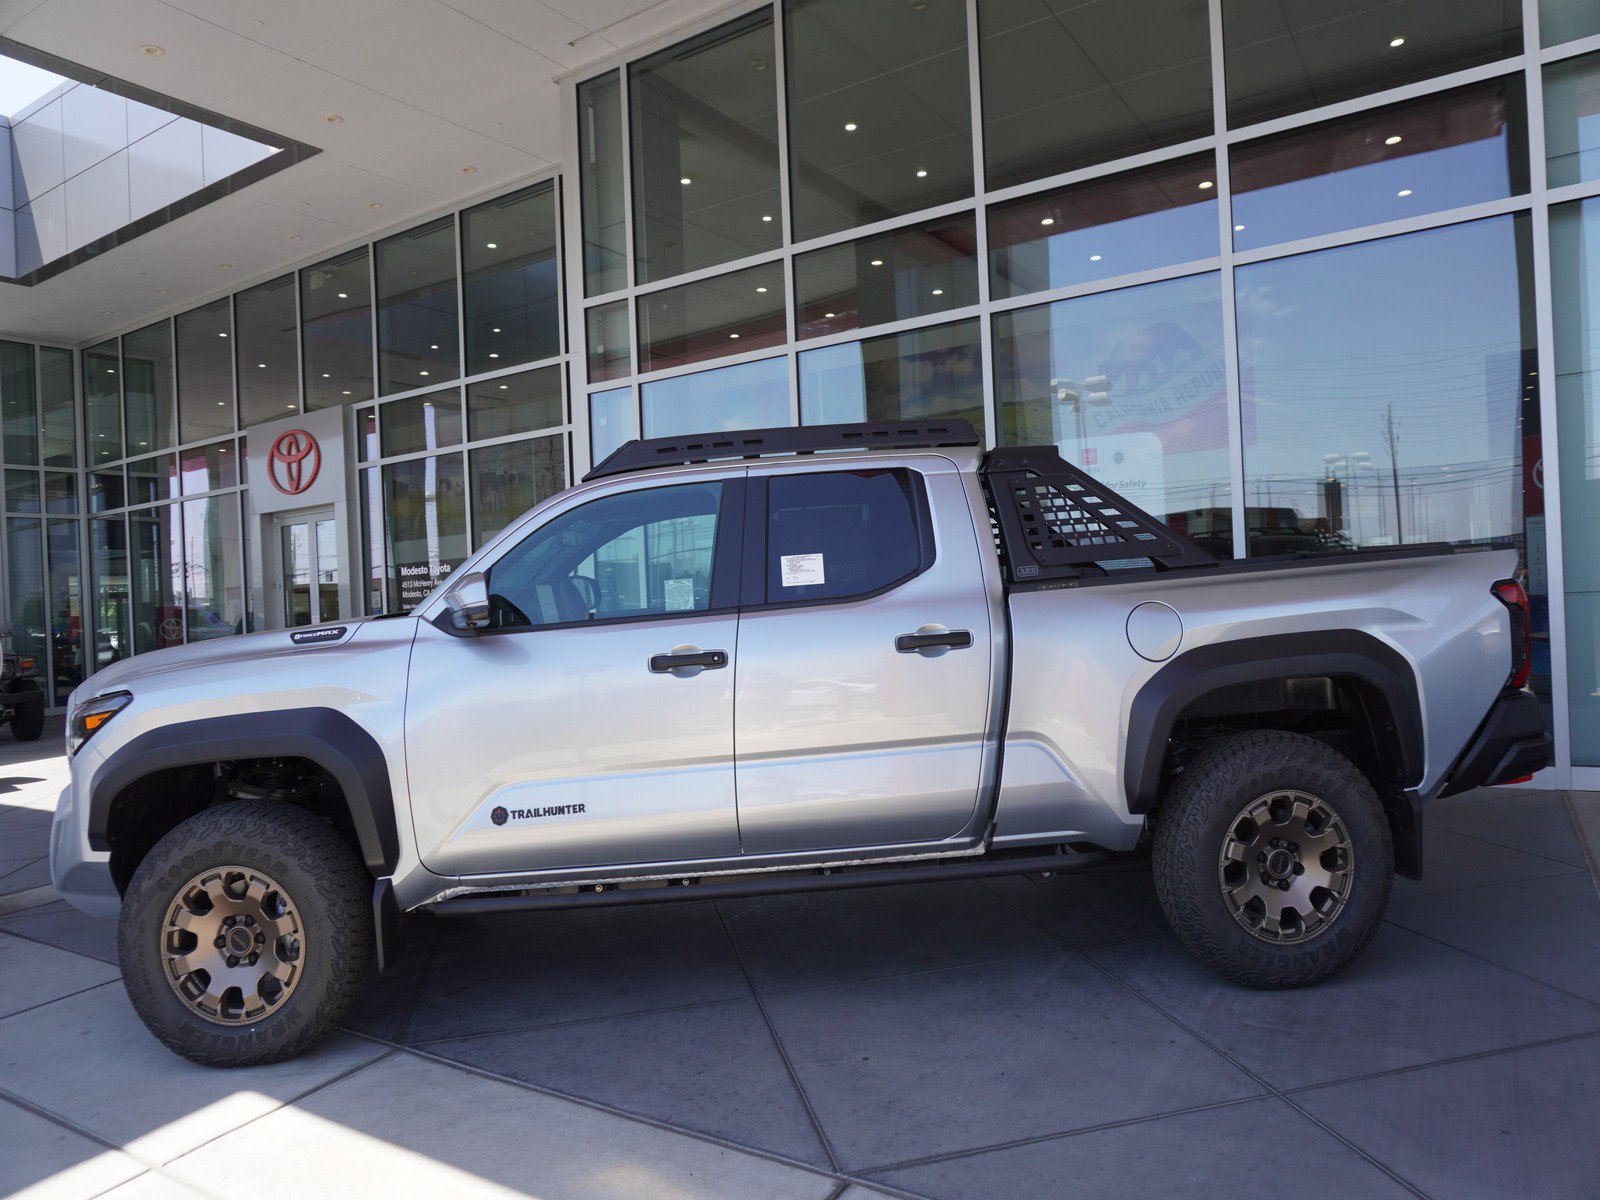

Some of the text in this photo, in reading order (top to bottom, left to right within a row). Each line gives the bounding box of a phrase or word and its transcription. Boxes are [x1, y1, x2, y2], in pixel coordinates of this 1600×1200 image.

[1119, 480, 1147, 490] Safety
[401, 563, 451, 576] Modesto Toyota
[1019, 567, 1037, 575] ARB
[402, 580, 413, 588] 4513
[413, 579, 433, 588] McHenry
[402, 590, 422, 599] Modesto,
[510, 803, 586, 820] TRAILHUNTER
